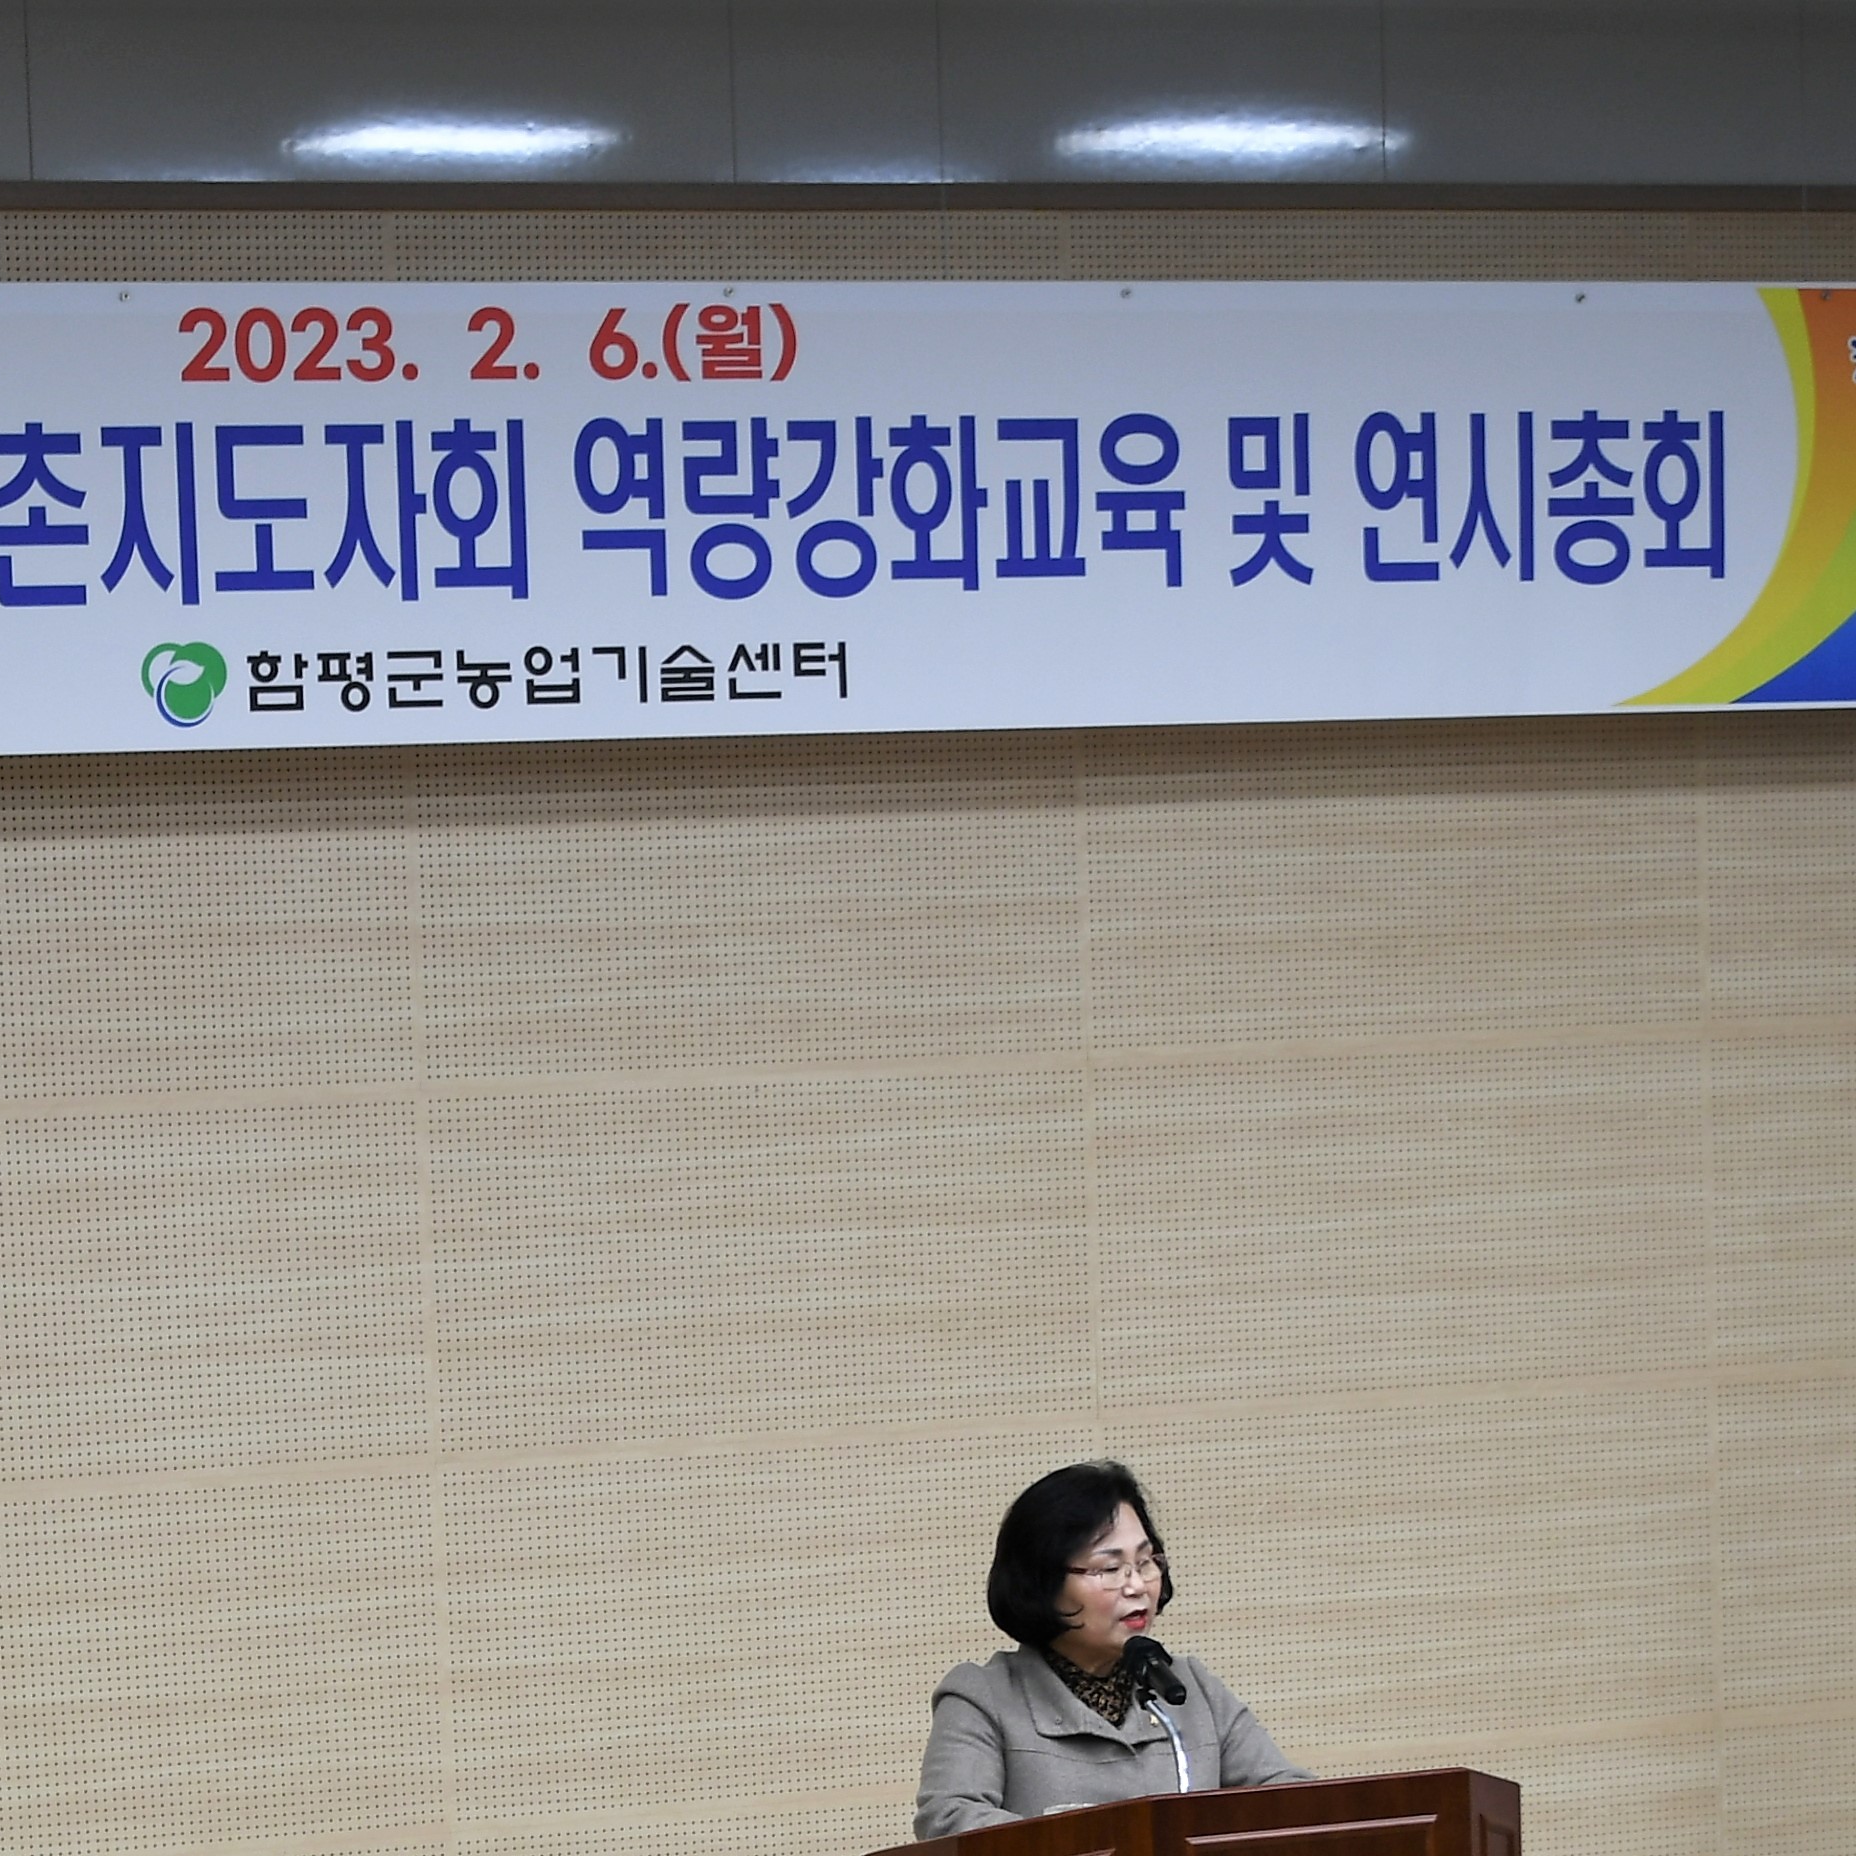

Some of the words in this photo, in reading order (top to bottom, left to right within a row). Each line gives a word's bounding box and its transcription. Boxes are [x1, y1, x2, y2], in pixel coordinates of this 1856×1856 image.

[178, 307, 419, 382] 2023.
[466, 307, 540, 380] 2.
[573, 412, 1188, 602] 역량강화교육
[1228, 412, 1316, 589] 및
[1354, 409, 1728, 588] 연시총회
[246, 641, 850, 714] 함평군농업기술센터
